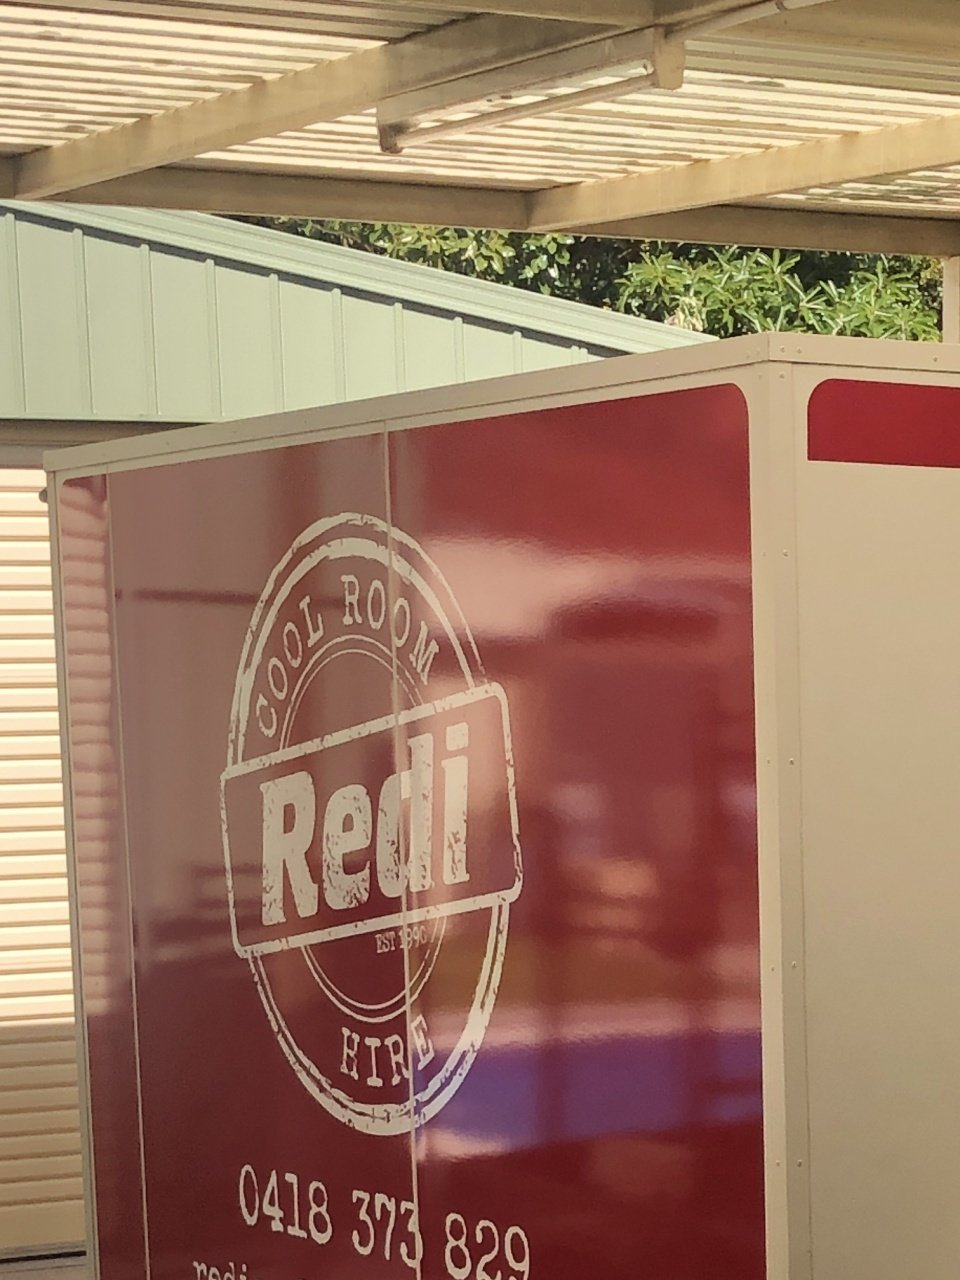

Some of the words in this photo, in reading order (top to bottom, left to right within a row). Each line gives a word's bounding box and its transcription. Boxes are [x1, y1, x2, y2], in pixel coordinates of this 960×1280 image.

[256, 596, 323, 738] COOL
[340, 574, 439, 685] ROOM
[259, 722, 470, 926] Redi
[340, 1014, 435, 1088] HIRE
[239, 1164, 332, 1244] 0418
[352, 1189, 423, 1269] 373
